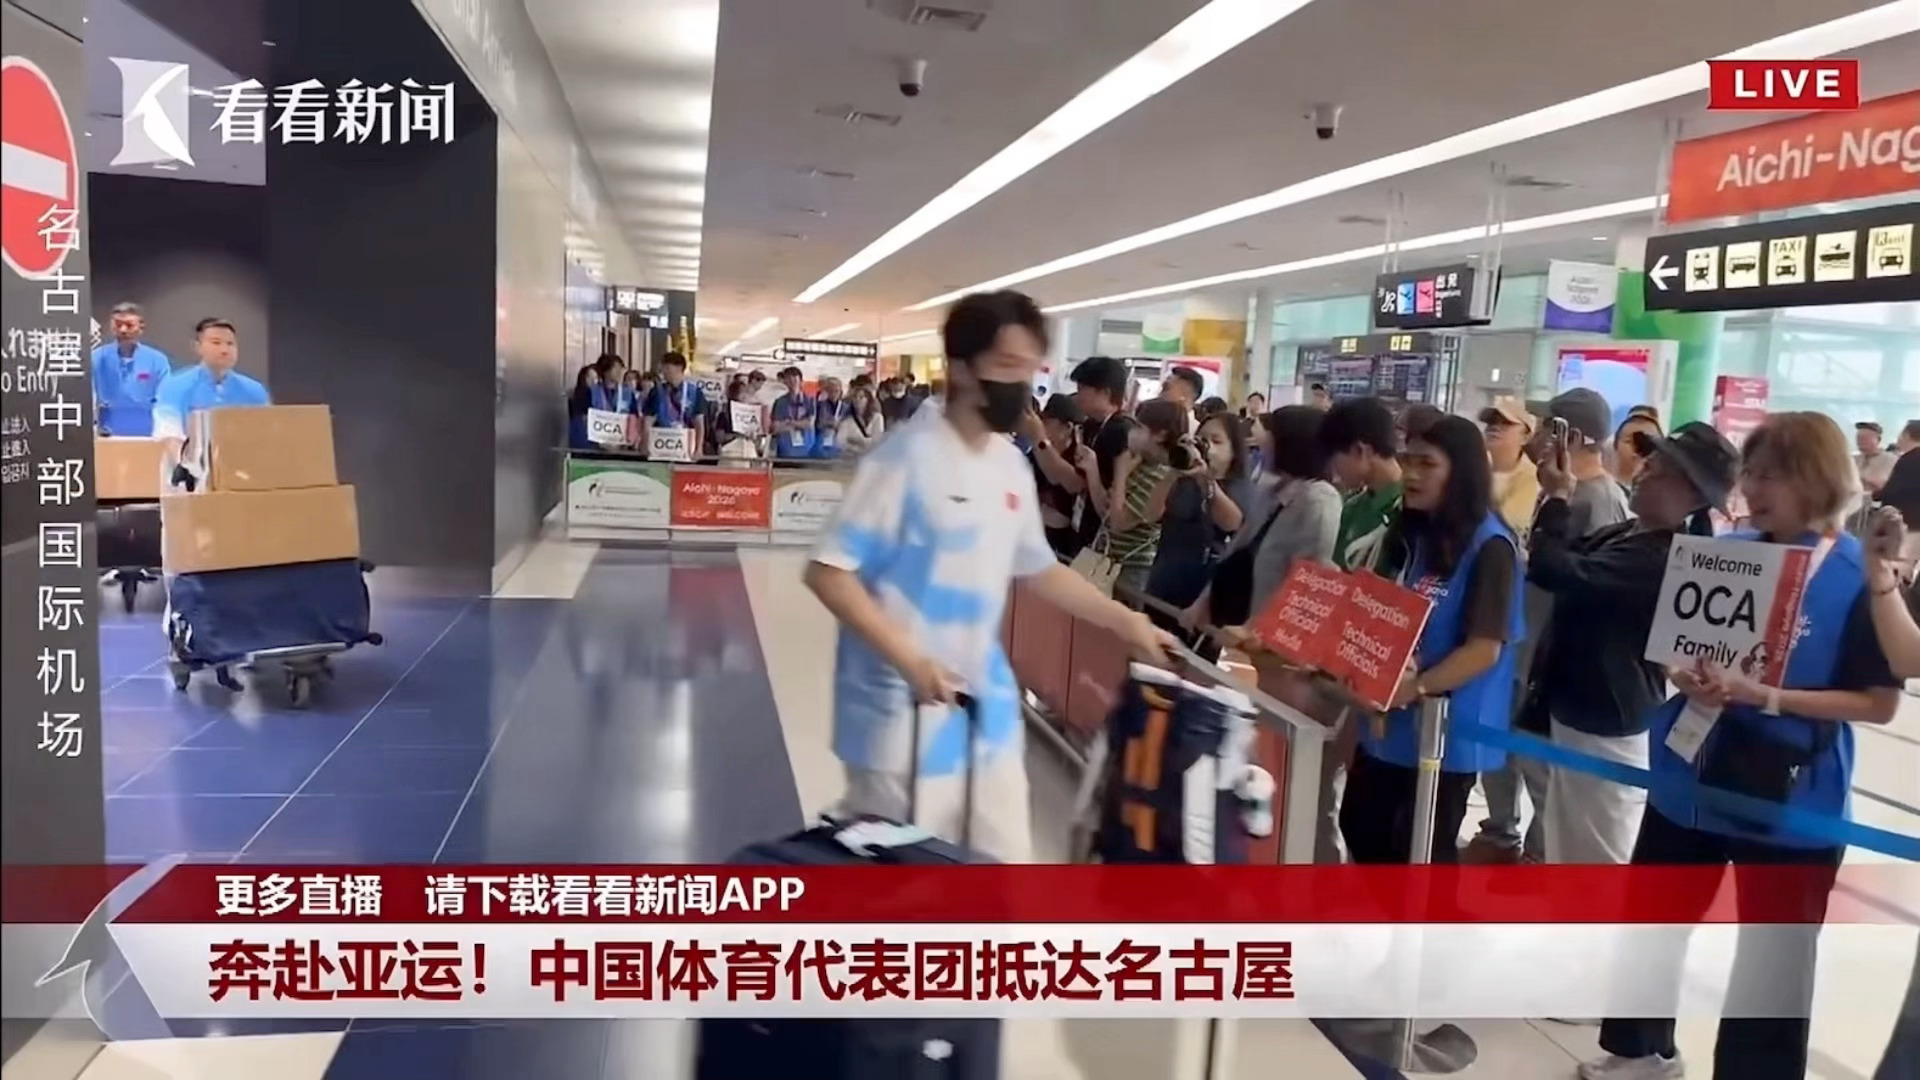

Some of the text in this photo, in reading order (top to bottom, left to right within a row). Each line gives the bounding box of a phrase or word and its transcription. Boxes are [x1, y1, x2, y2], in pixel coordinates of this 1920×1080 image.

[1773, 242, 1802, 254] TAXI
[17, 366, 59, 398] Entry
[593, 420, 622, 435] OCA
[654, 438, 683, 450] OCA
[1691, 552, 1763, 577] Welcome
[1287, 589, 1337, 619] Technical
[1351, 586, 1410, 629] Delegation
[1673, 581, 1756, 633] OCA
[1278, 605, 1321, 635] Officials
[1343, 620, 1393, 662] Technical
[1673, 634, 1738, 670] Family
[1335, 641, 1381, 679] Officials
